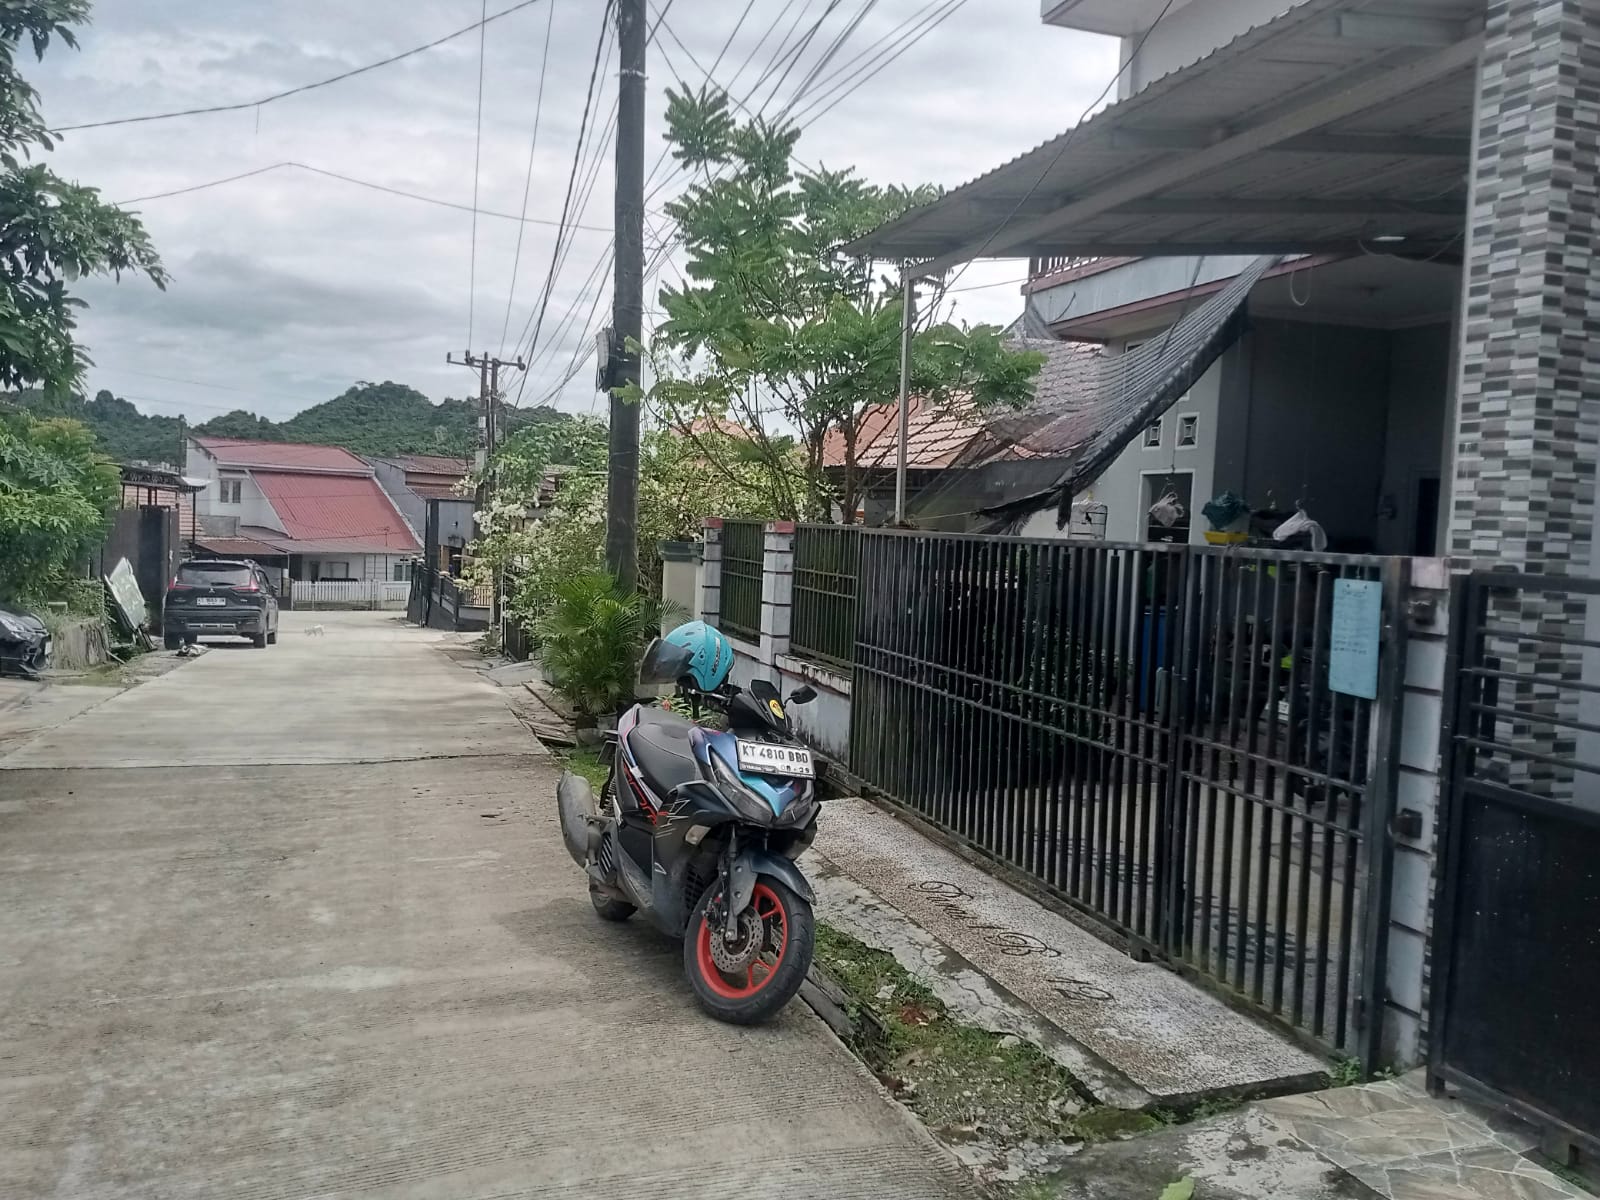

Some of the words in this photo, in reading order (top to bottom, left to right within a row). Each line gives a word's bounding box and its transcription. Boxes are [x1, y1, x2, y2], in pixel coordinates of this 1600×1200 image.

[743, 744, 756, 757] KT
[760, 748, 785, 760] 4810
[1047, 976, 1114, 1001] 12
